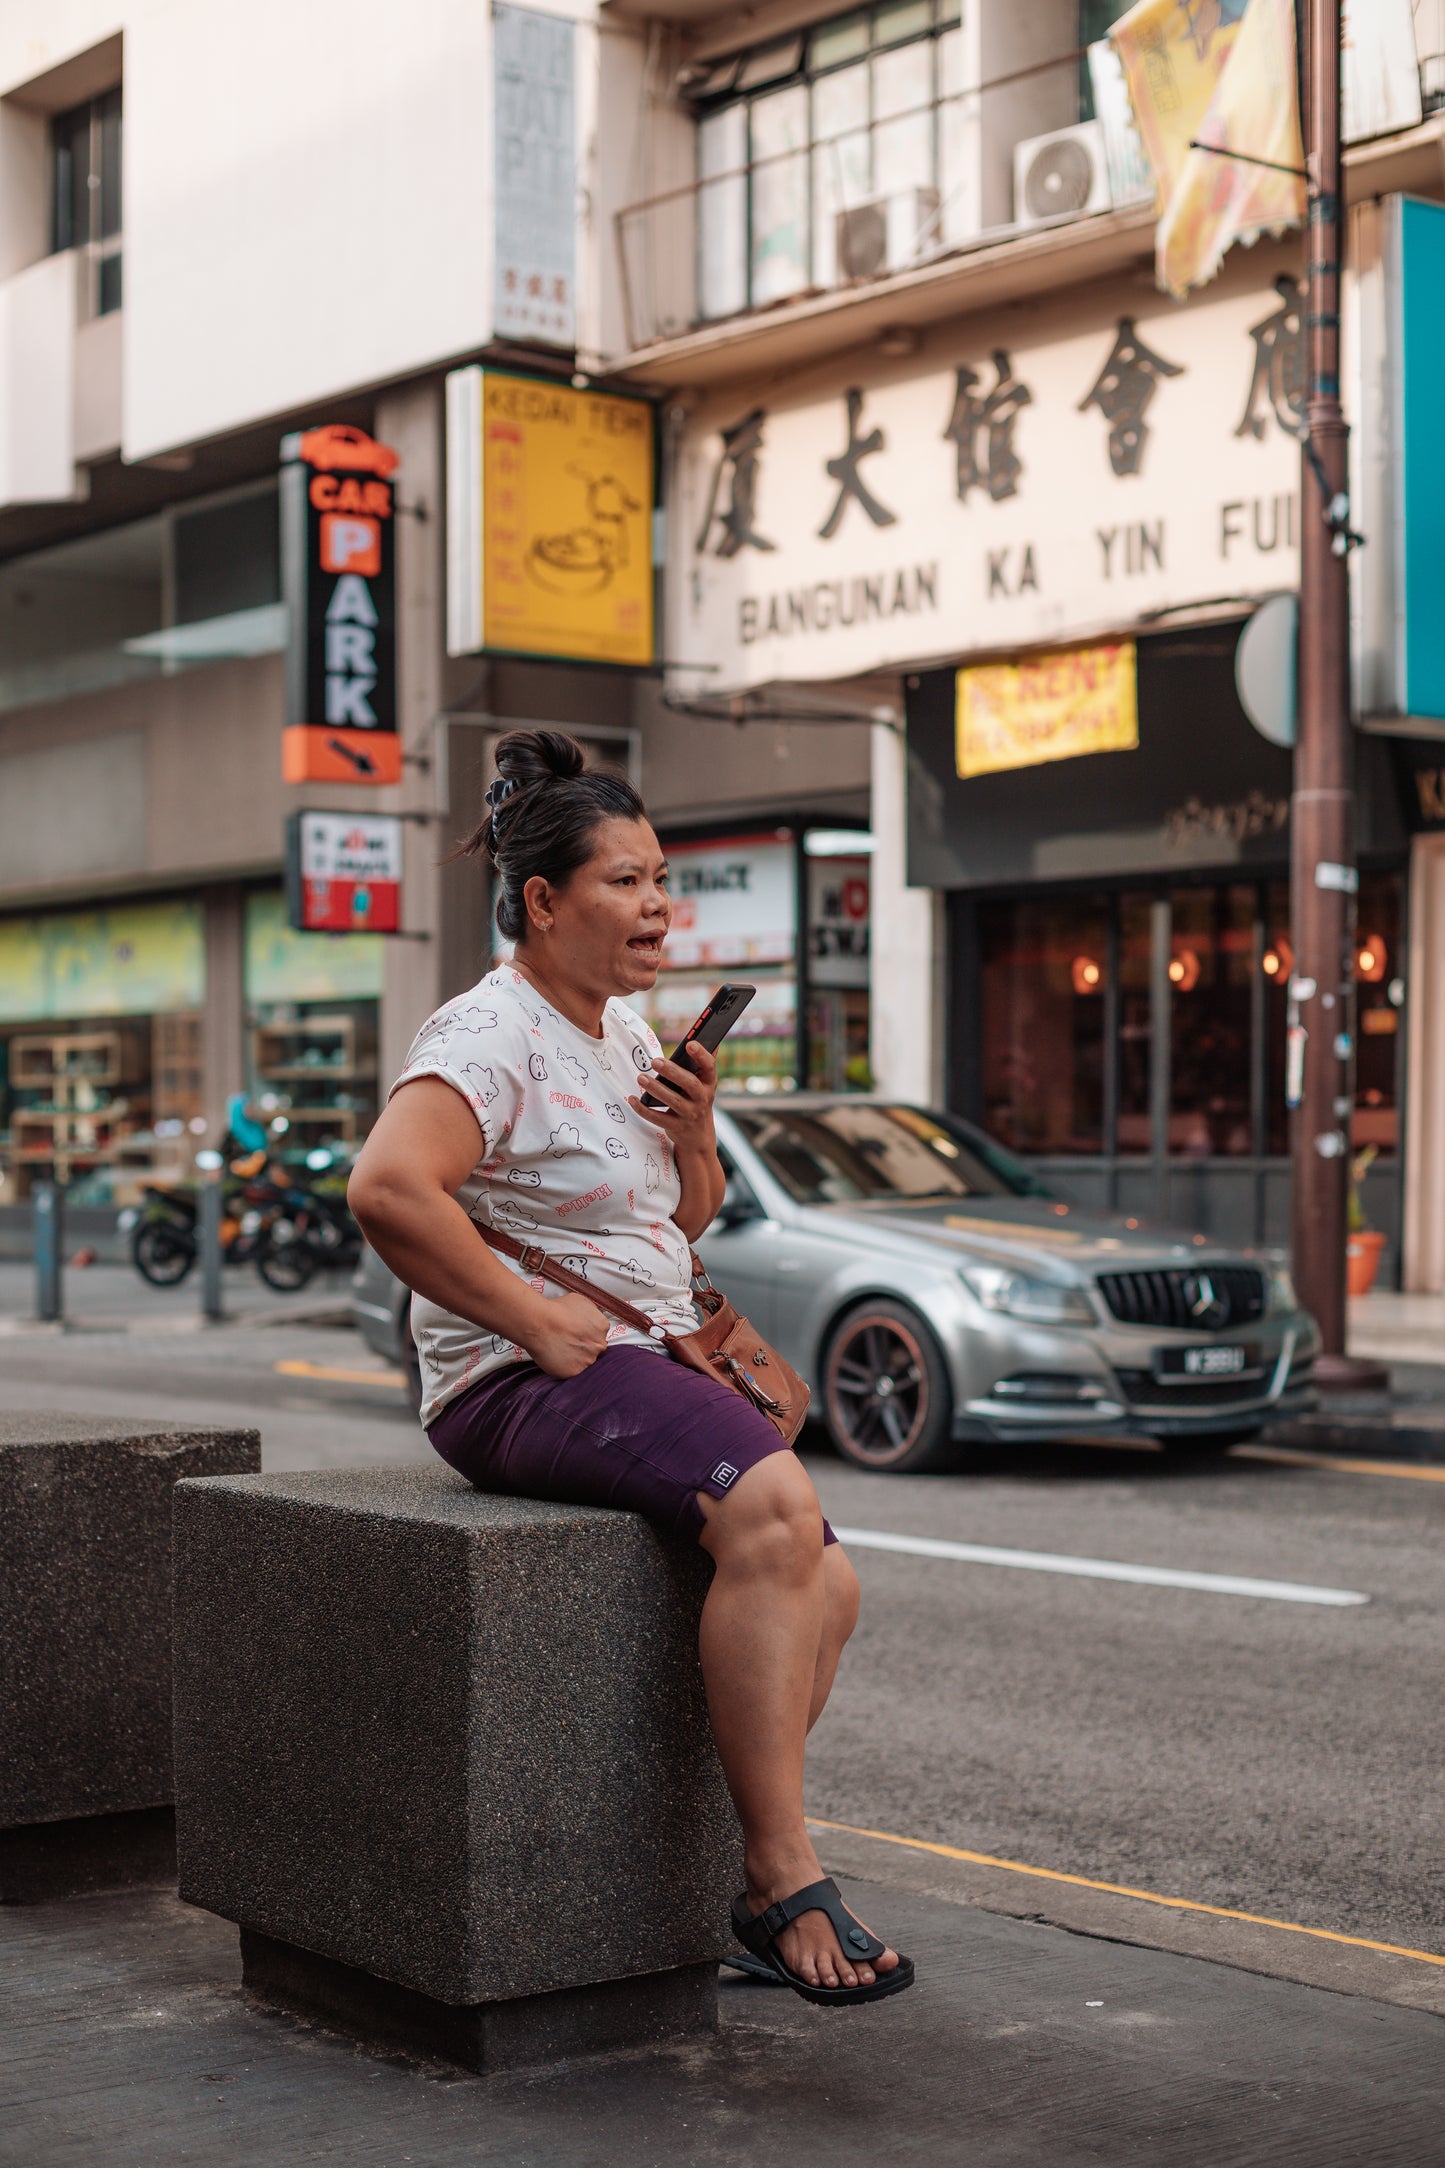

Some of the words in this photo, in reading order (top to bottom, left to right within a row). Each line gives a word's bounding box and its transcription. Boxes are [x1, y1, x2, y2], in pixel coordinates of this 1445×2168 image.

[308, 474, 393, 520] CAR
[324, 518, 380, 728] PARK
[737, 562, 939, 646] BANGUNAN
[986, 544, 1040, 600] KA
[1096, 519, 1165, 580] YIN
[555, 1183, 613, 1217] Hello!
